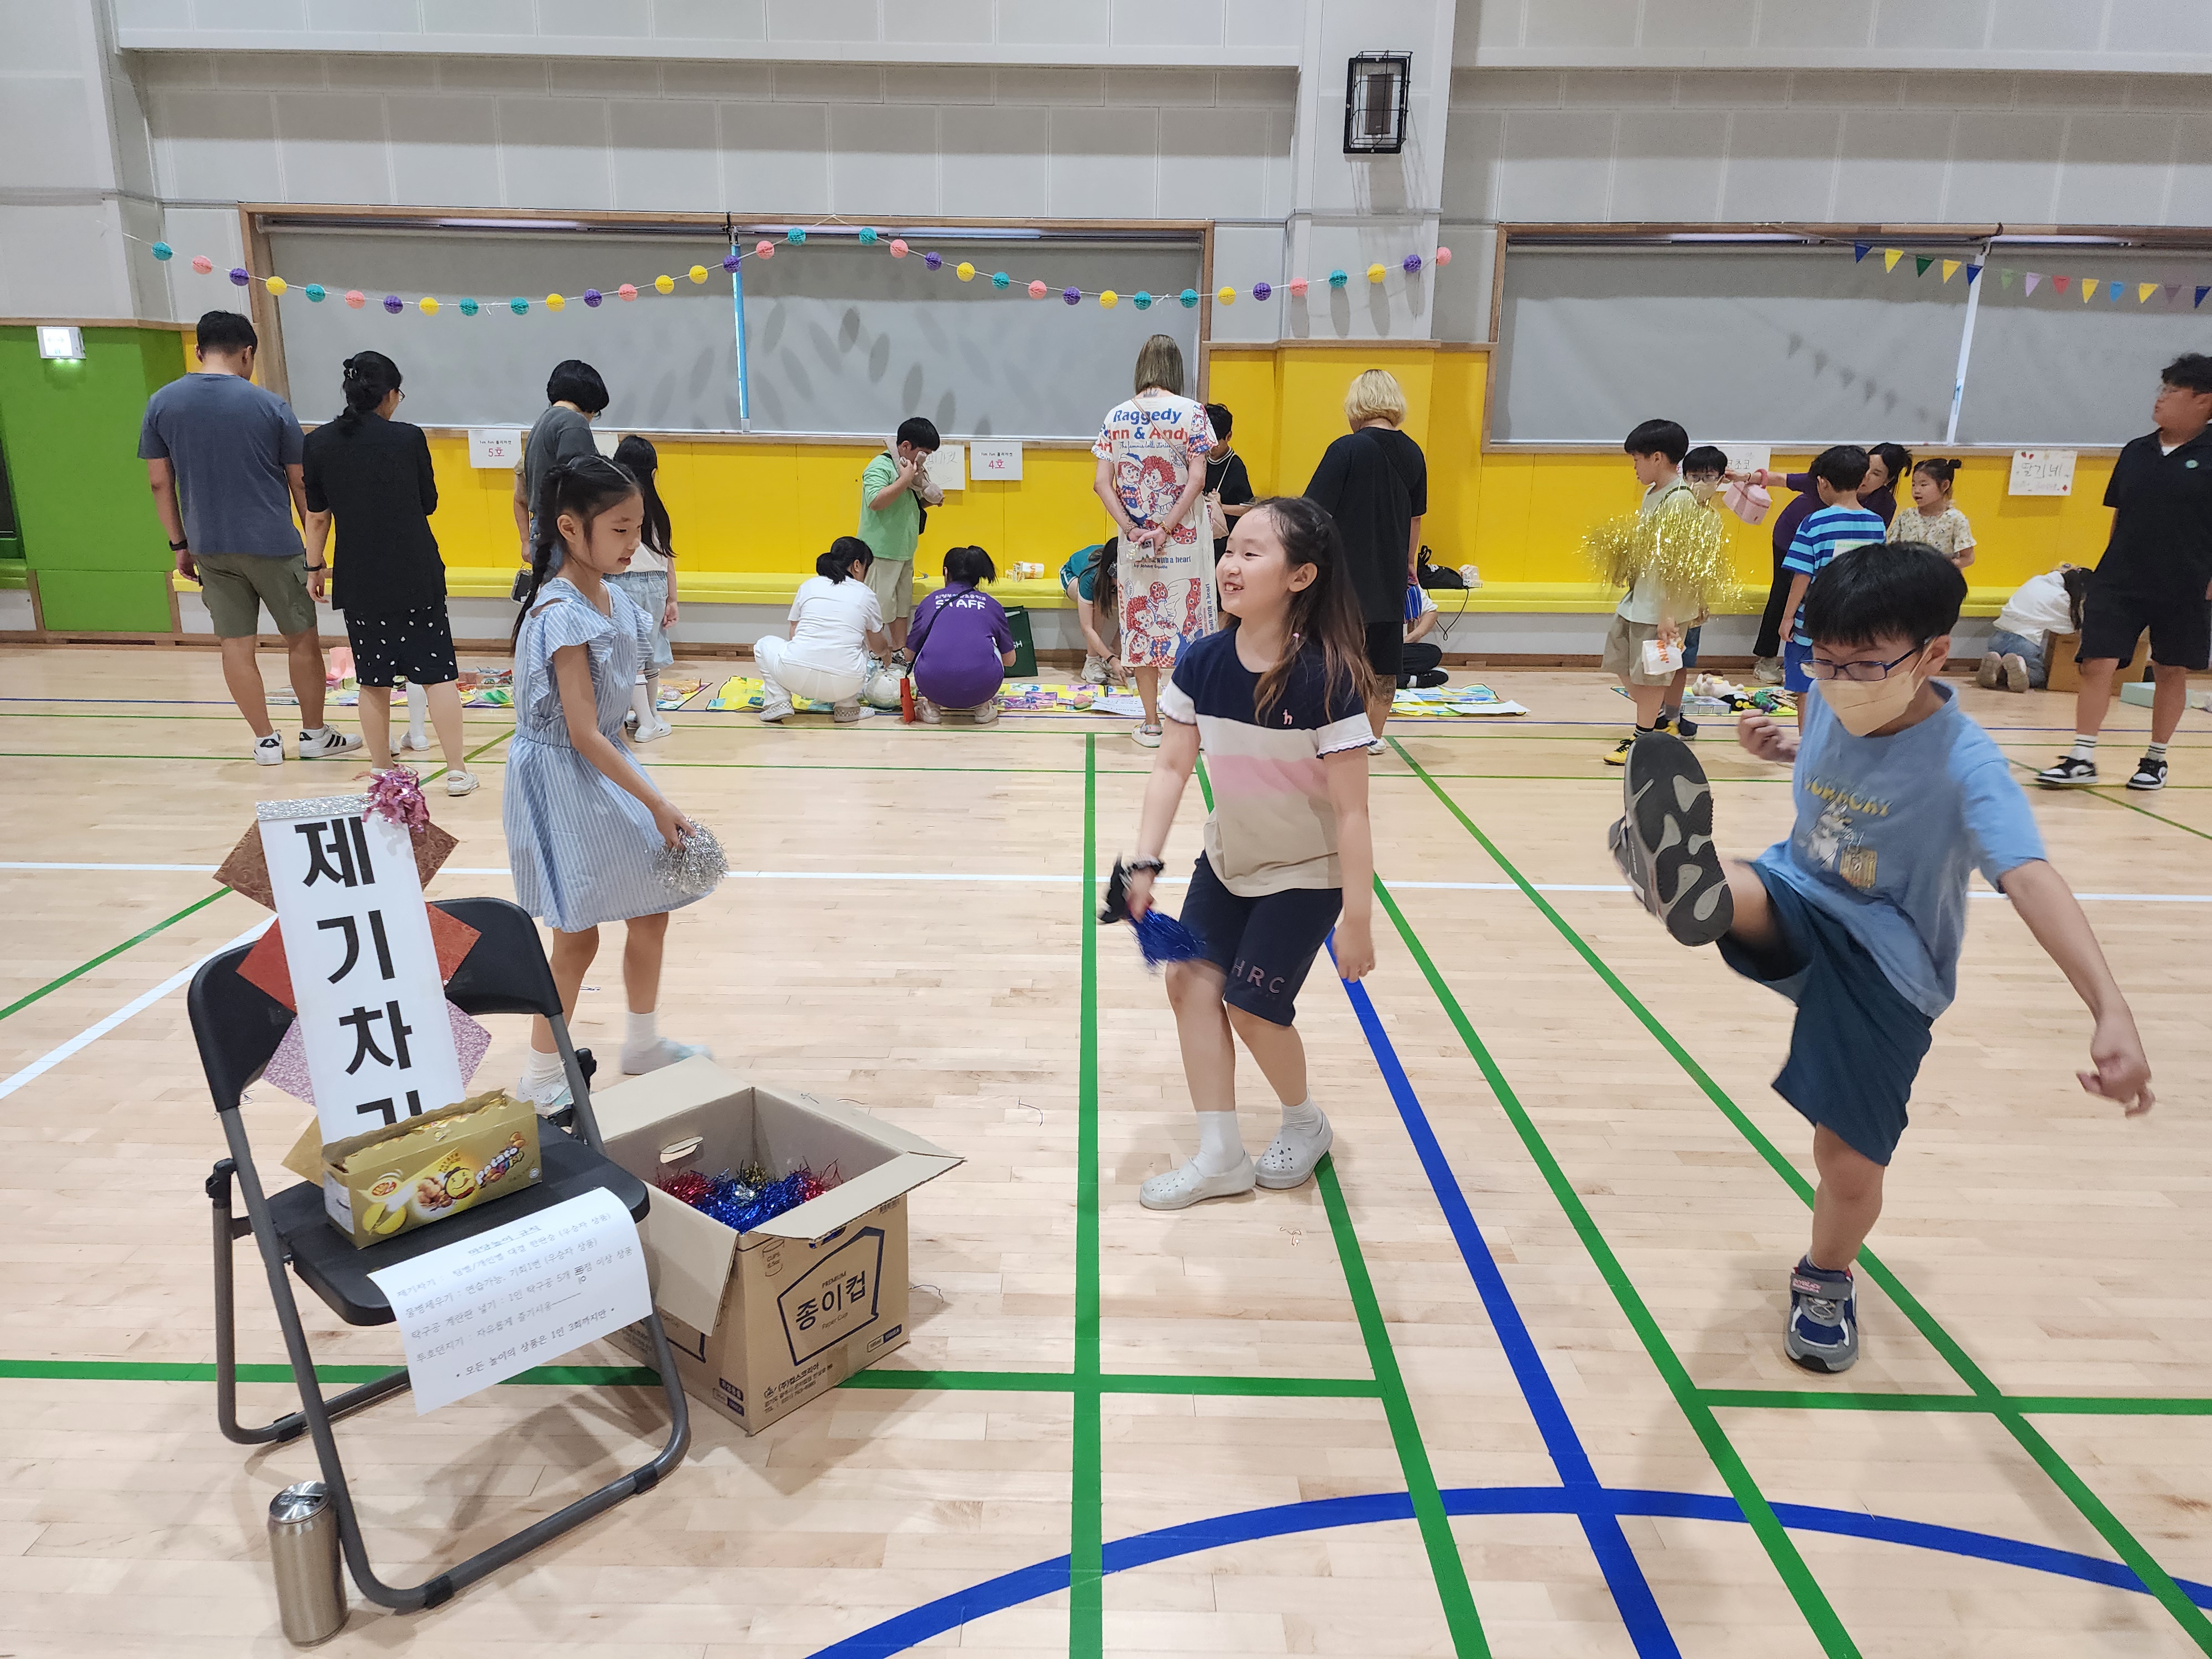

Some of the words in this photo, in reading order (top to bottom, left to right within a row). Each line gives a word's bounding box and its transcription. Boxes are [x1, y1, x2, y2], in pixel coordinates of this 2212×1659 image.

[1113, 408, 1182, 425] Raggedy
[1134, 427, 1145, 440] &
[1149, 427, 1190, 445] Andy
[488, 447, 505, 457] 5호
[988, 460, 1005, 469] 4호
[935, 599, 985, 610] STAFF
[397, 1279, 436, 1297] 제기차기
[411, 1322, 441, 1339] 탁구공
[526, 1277, 553, 1293] 탁구공
[796, 1270, 865, 1331] 종이컵
[466, 1361, 484, 1375] 모든
[489, 1347, 515, 1367] 놀이의
[521, 1335, 547, 1352] 상품은
